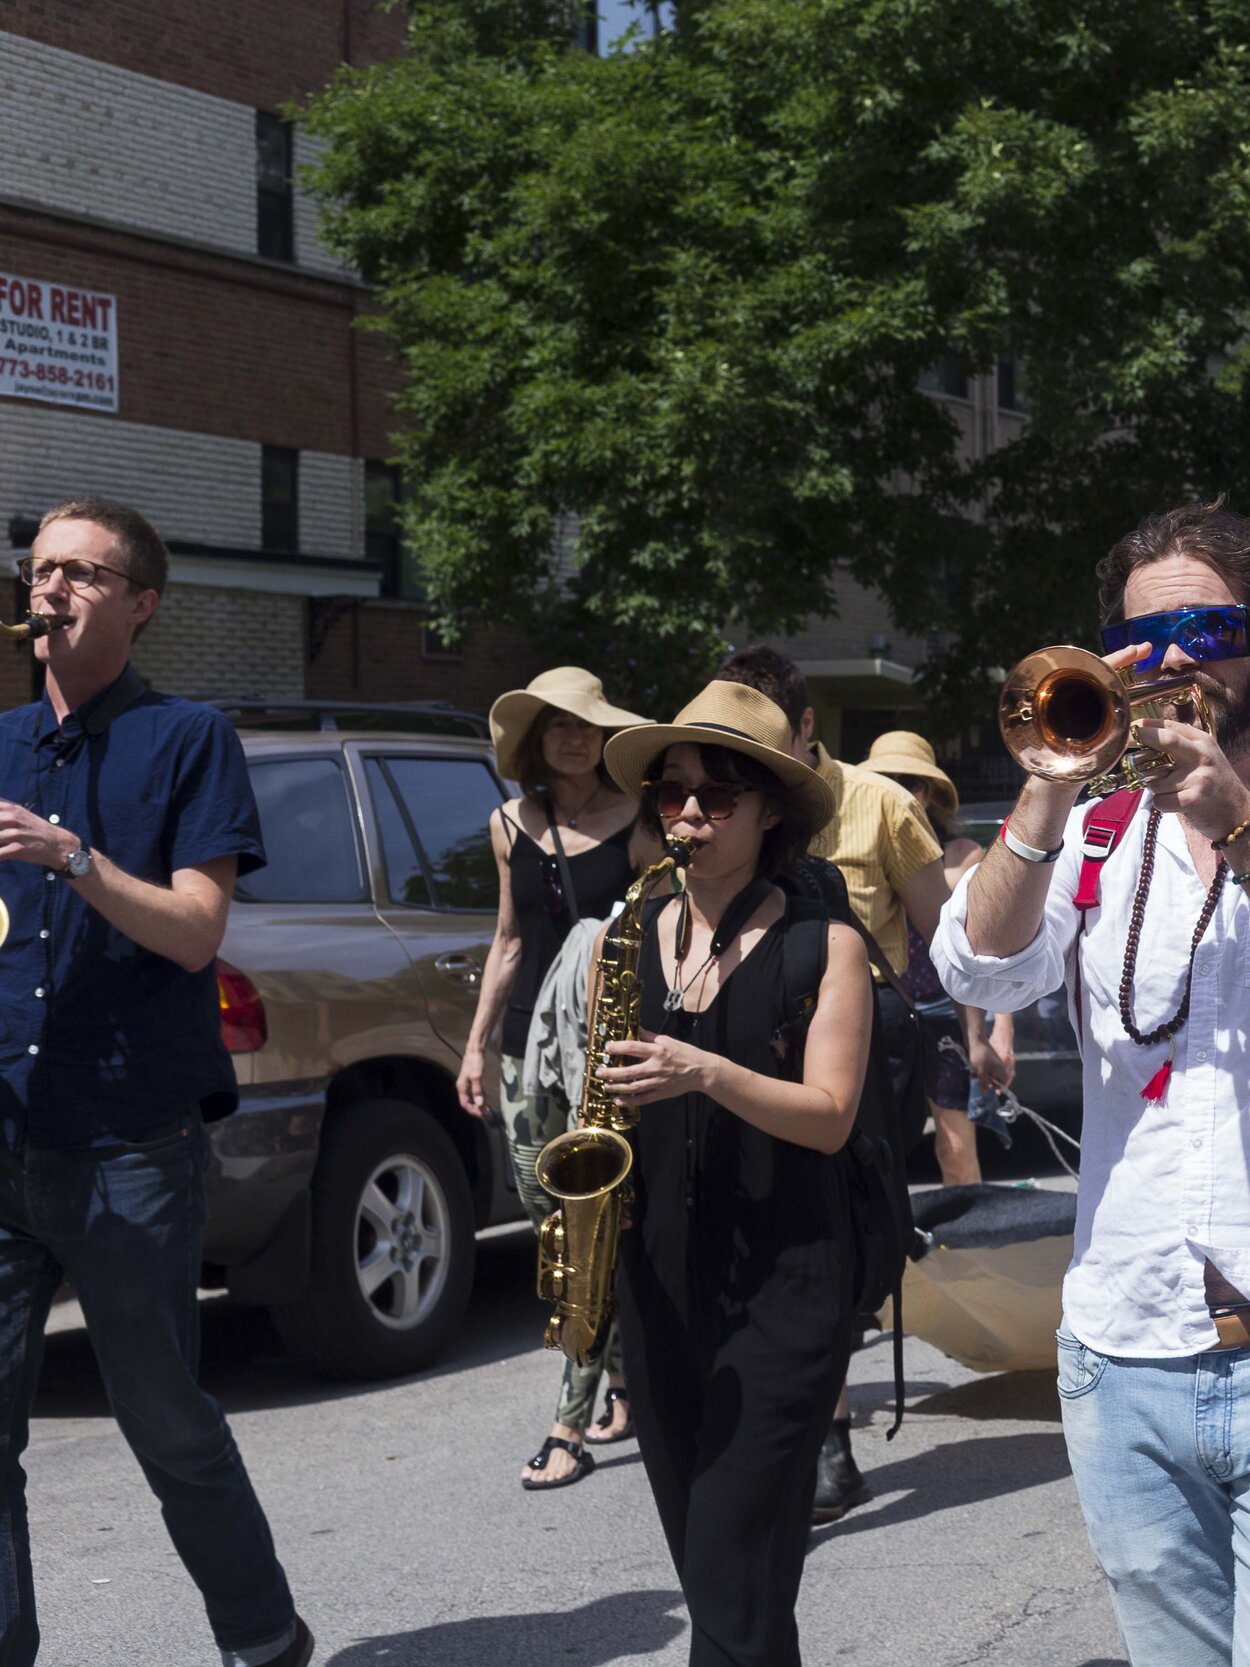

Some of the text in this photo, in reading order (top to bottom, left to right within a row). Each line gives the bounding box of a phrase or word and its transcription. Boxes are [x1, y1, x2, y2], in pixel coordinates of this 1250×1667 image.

[0, 277, 112, 332] FOR RENT
[0, 319, 109, 352] STUDIO, 1 & 2 BR
[4, 338, 106, 366] Apartments
[0, 356, 114, 392] 773-858-2161
